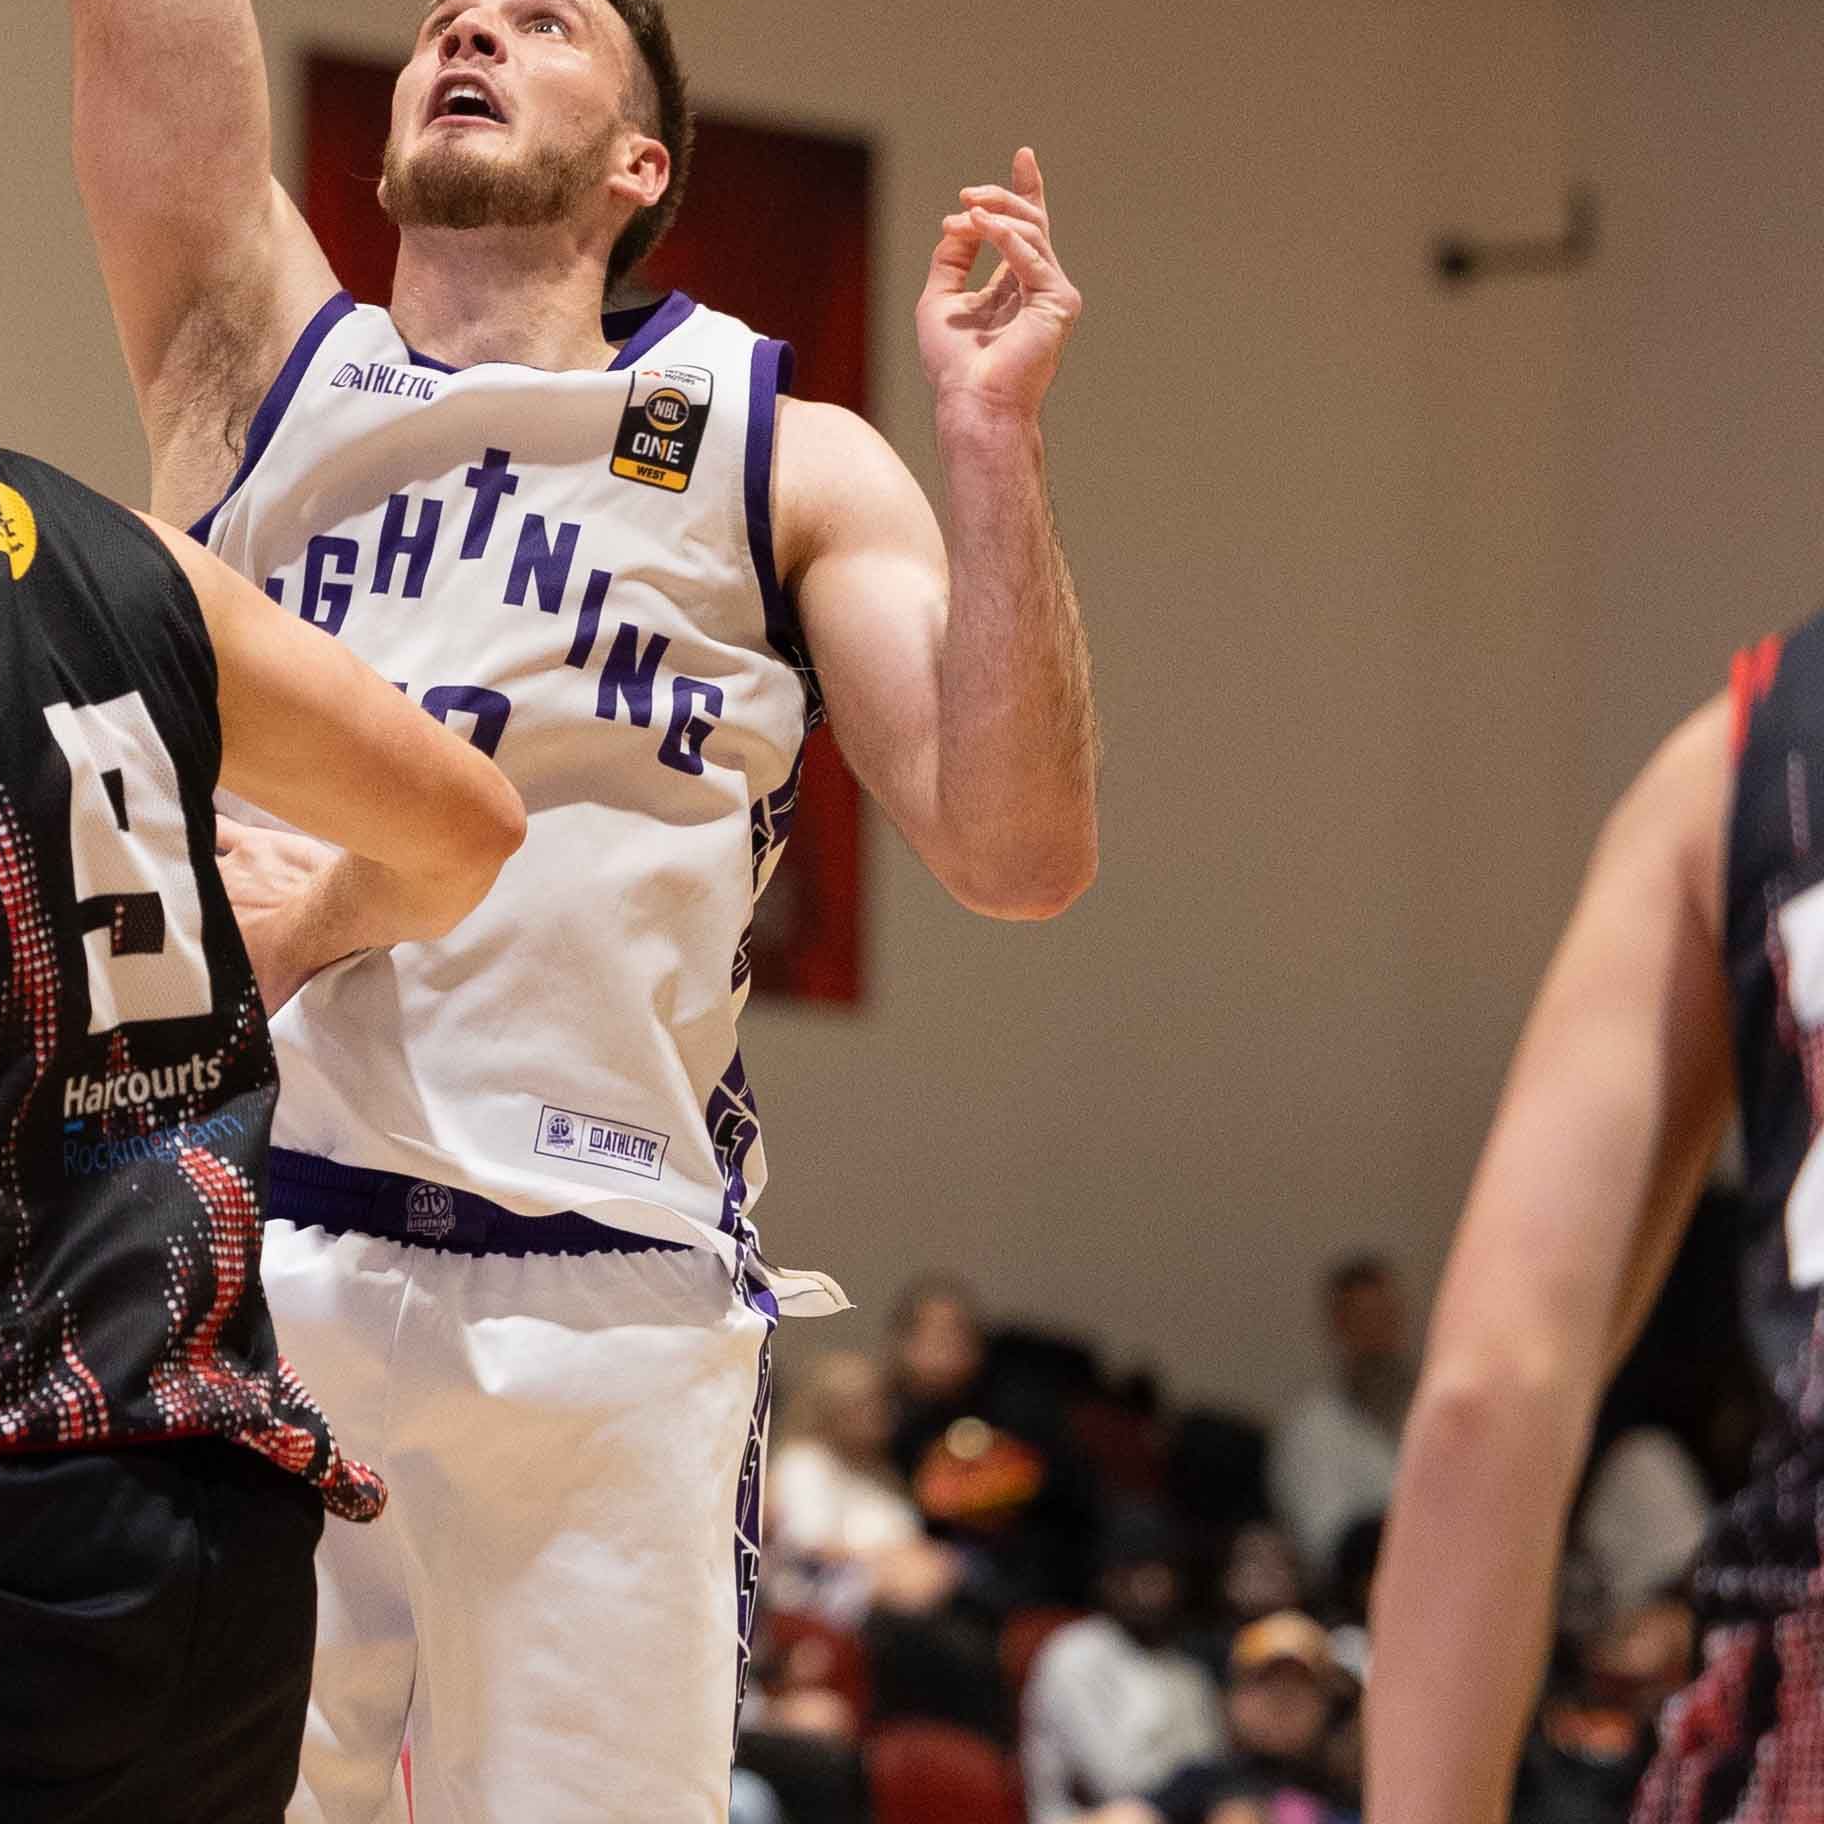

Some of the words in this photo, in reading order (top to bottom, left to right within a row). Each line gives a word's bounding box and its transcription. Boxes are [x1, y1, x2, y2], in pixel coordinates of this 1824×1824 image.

[654, 399, 681, 421] NBL
[632, 432, 684, 464] ONE
[637, 465, 667, 481] WEST
[264, 448, 724, 776] GHTNING
[42, 690, 214, 1035] 9
[64, 1053, 223, 1118] Harcourts
[64, 1114, 244, 1175] Rockingham
[603, 1129, 657, 1162] ATHLETIC
